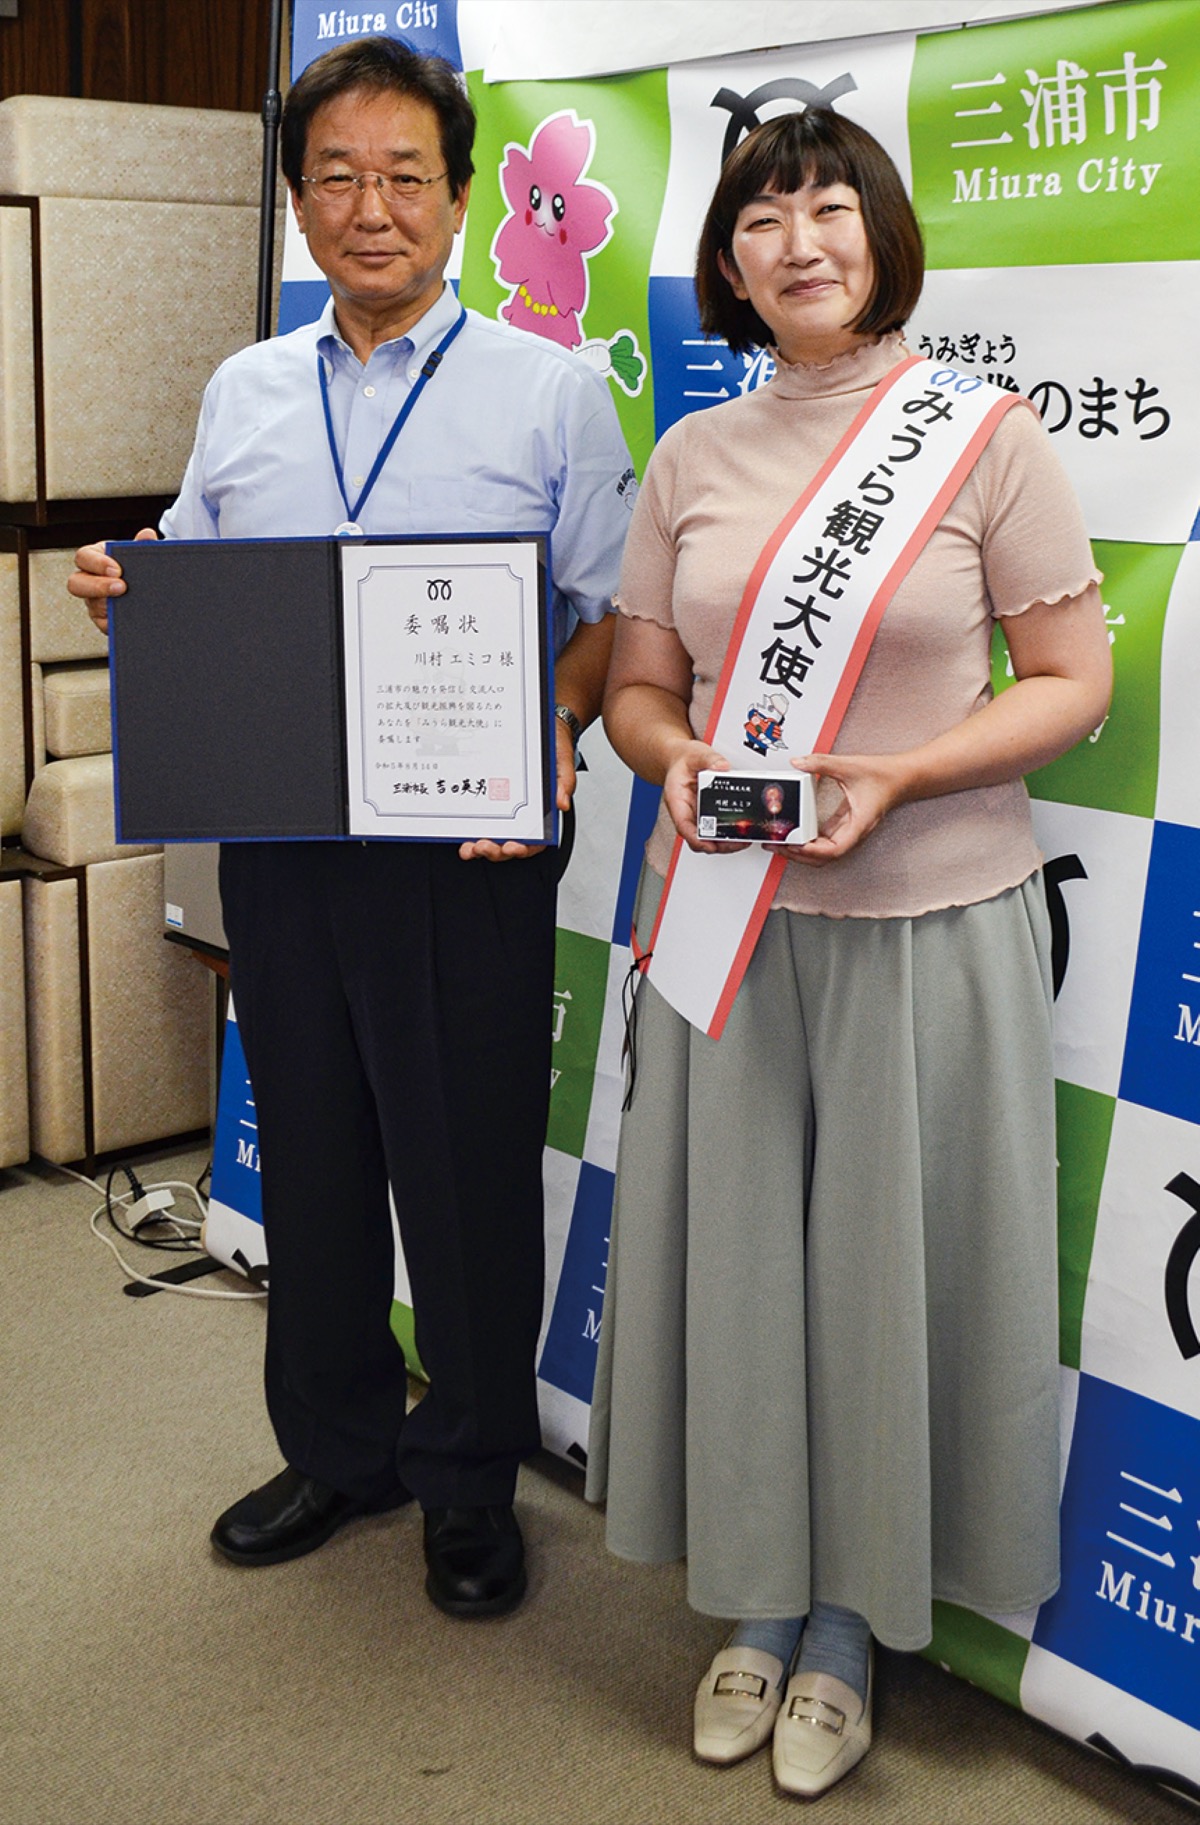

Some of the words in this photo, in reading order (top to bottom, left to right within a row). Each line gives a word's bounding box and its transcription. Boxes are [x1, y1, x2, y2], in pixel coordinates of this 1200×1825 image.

[316, 10, 388, 40] Miura
[396, 0, 438, 29] City
[951, 51, 1168, 150] 三浦市
[952, 166, 1063, 203] Miura
[1077, 156, 1163, 196] City
[919, 333, 1017, 364] うみぎょう
[760, 390, 954, 699] みうら観光大使
